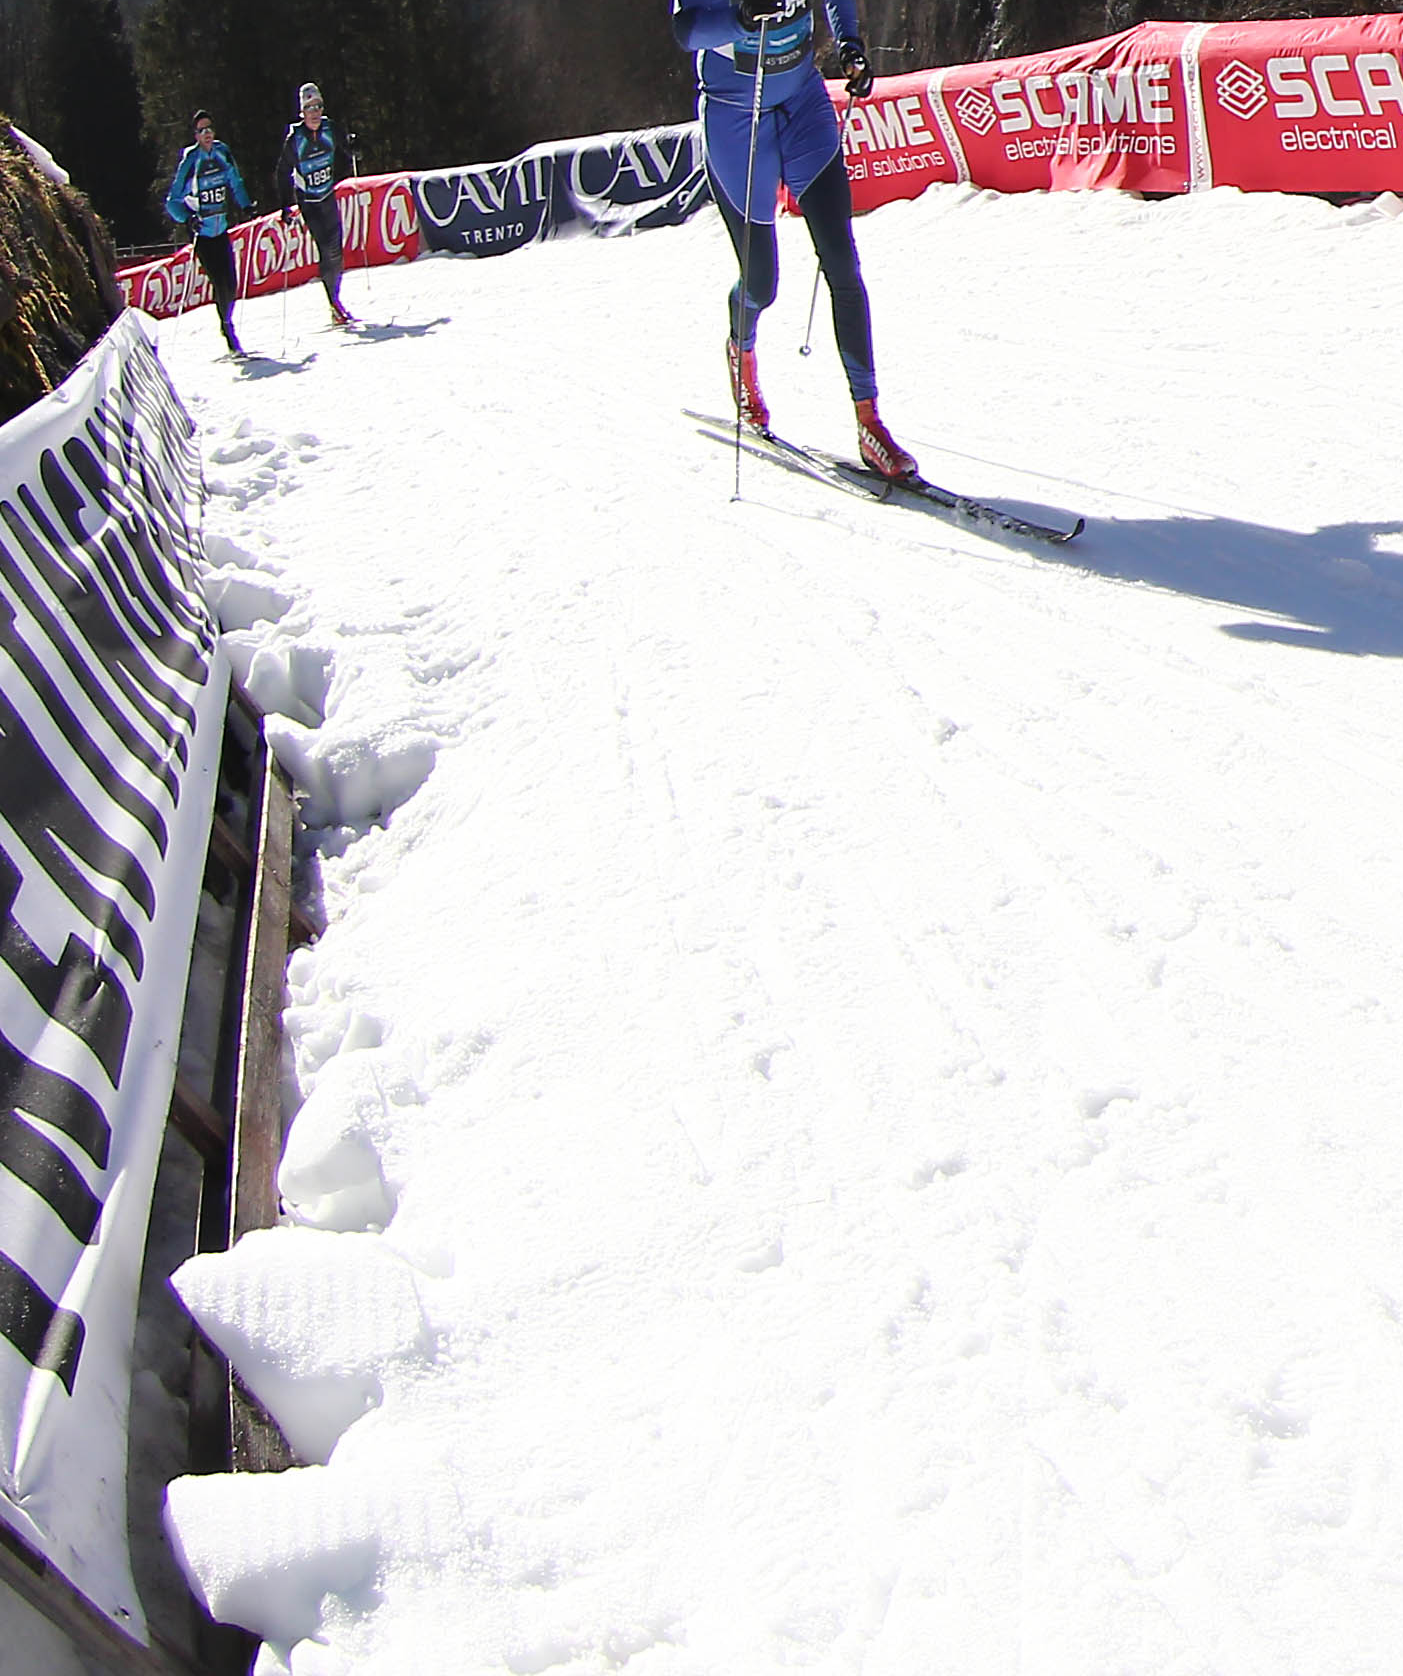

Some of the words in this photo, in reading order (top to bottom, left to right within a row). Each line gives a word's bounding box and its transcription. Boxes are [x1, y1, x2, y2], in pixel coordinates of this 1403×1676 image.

[991, 63, 1175, 135] SCAME
[842, 95, 936, 155] AME
[1281, 121, 1397, 152] electrical
[872, 150, 946, 177] solutions
[416, 155, 556, 227] CAVIT
[461, 222, 525, 245] TRENTO
